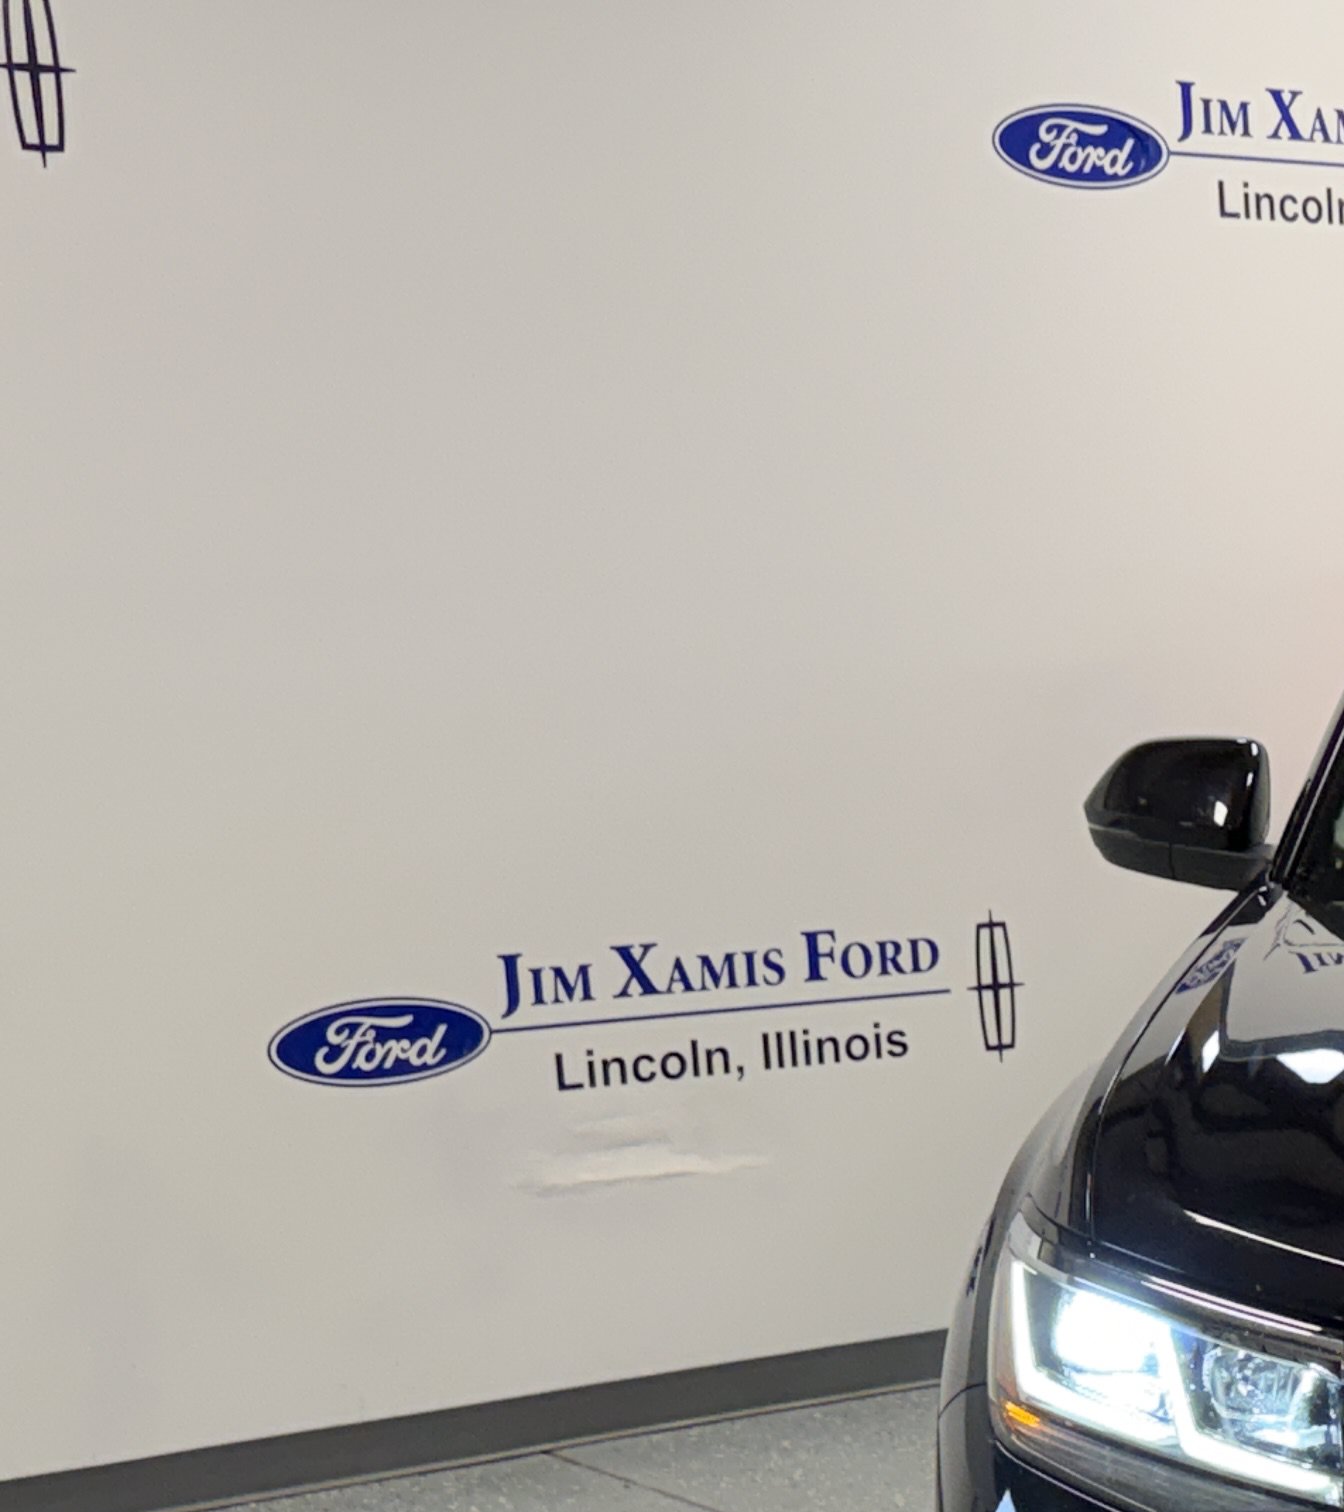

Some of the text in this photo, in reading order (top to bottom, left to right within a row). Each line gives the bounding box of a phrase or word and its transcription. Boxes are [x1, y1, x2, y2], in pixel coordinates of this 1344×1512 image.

[1176, 80, 1253, 142] JIM
[1029, 116, 1135, 177] Ford
[497, 930, 939, 1018] JIM XAMIS FORD
[314, 1014, 447, 1074] Ford
[555, 1023, 909, 1091] Lincoln, Illinois
